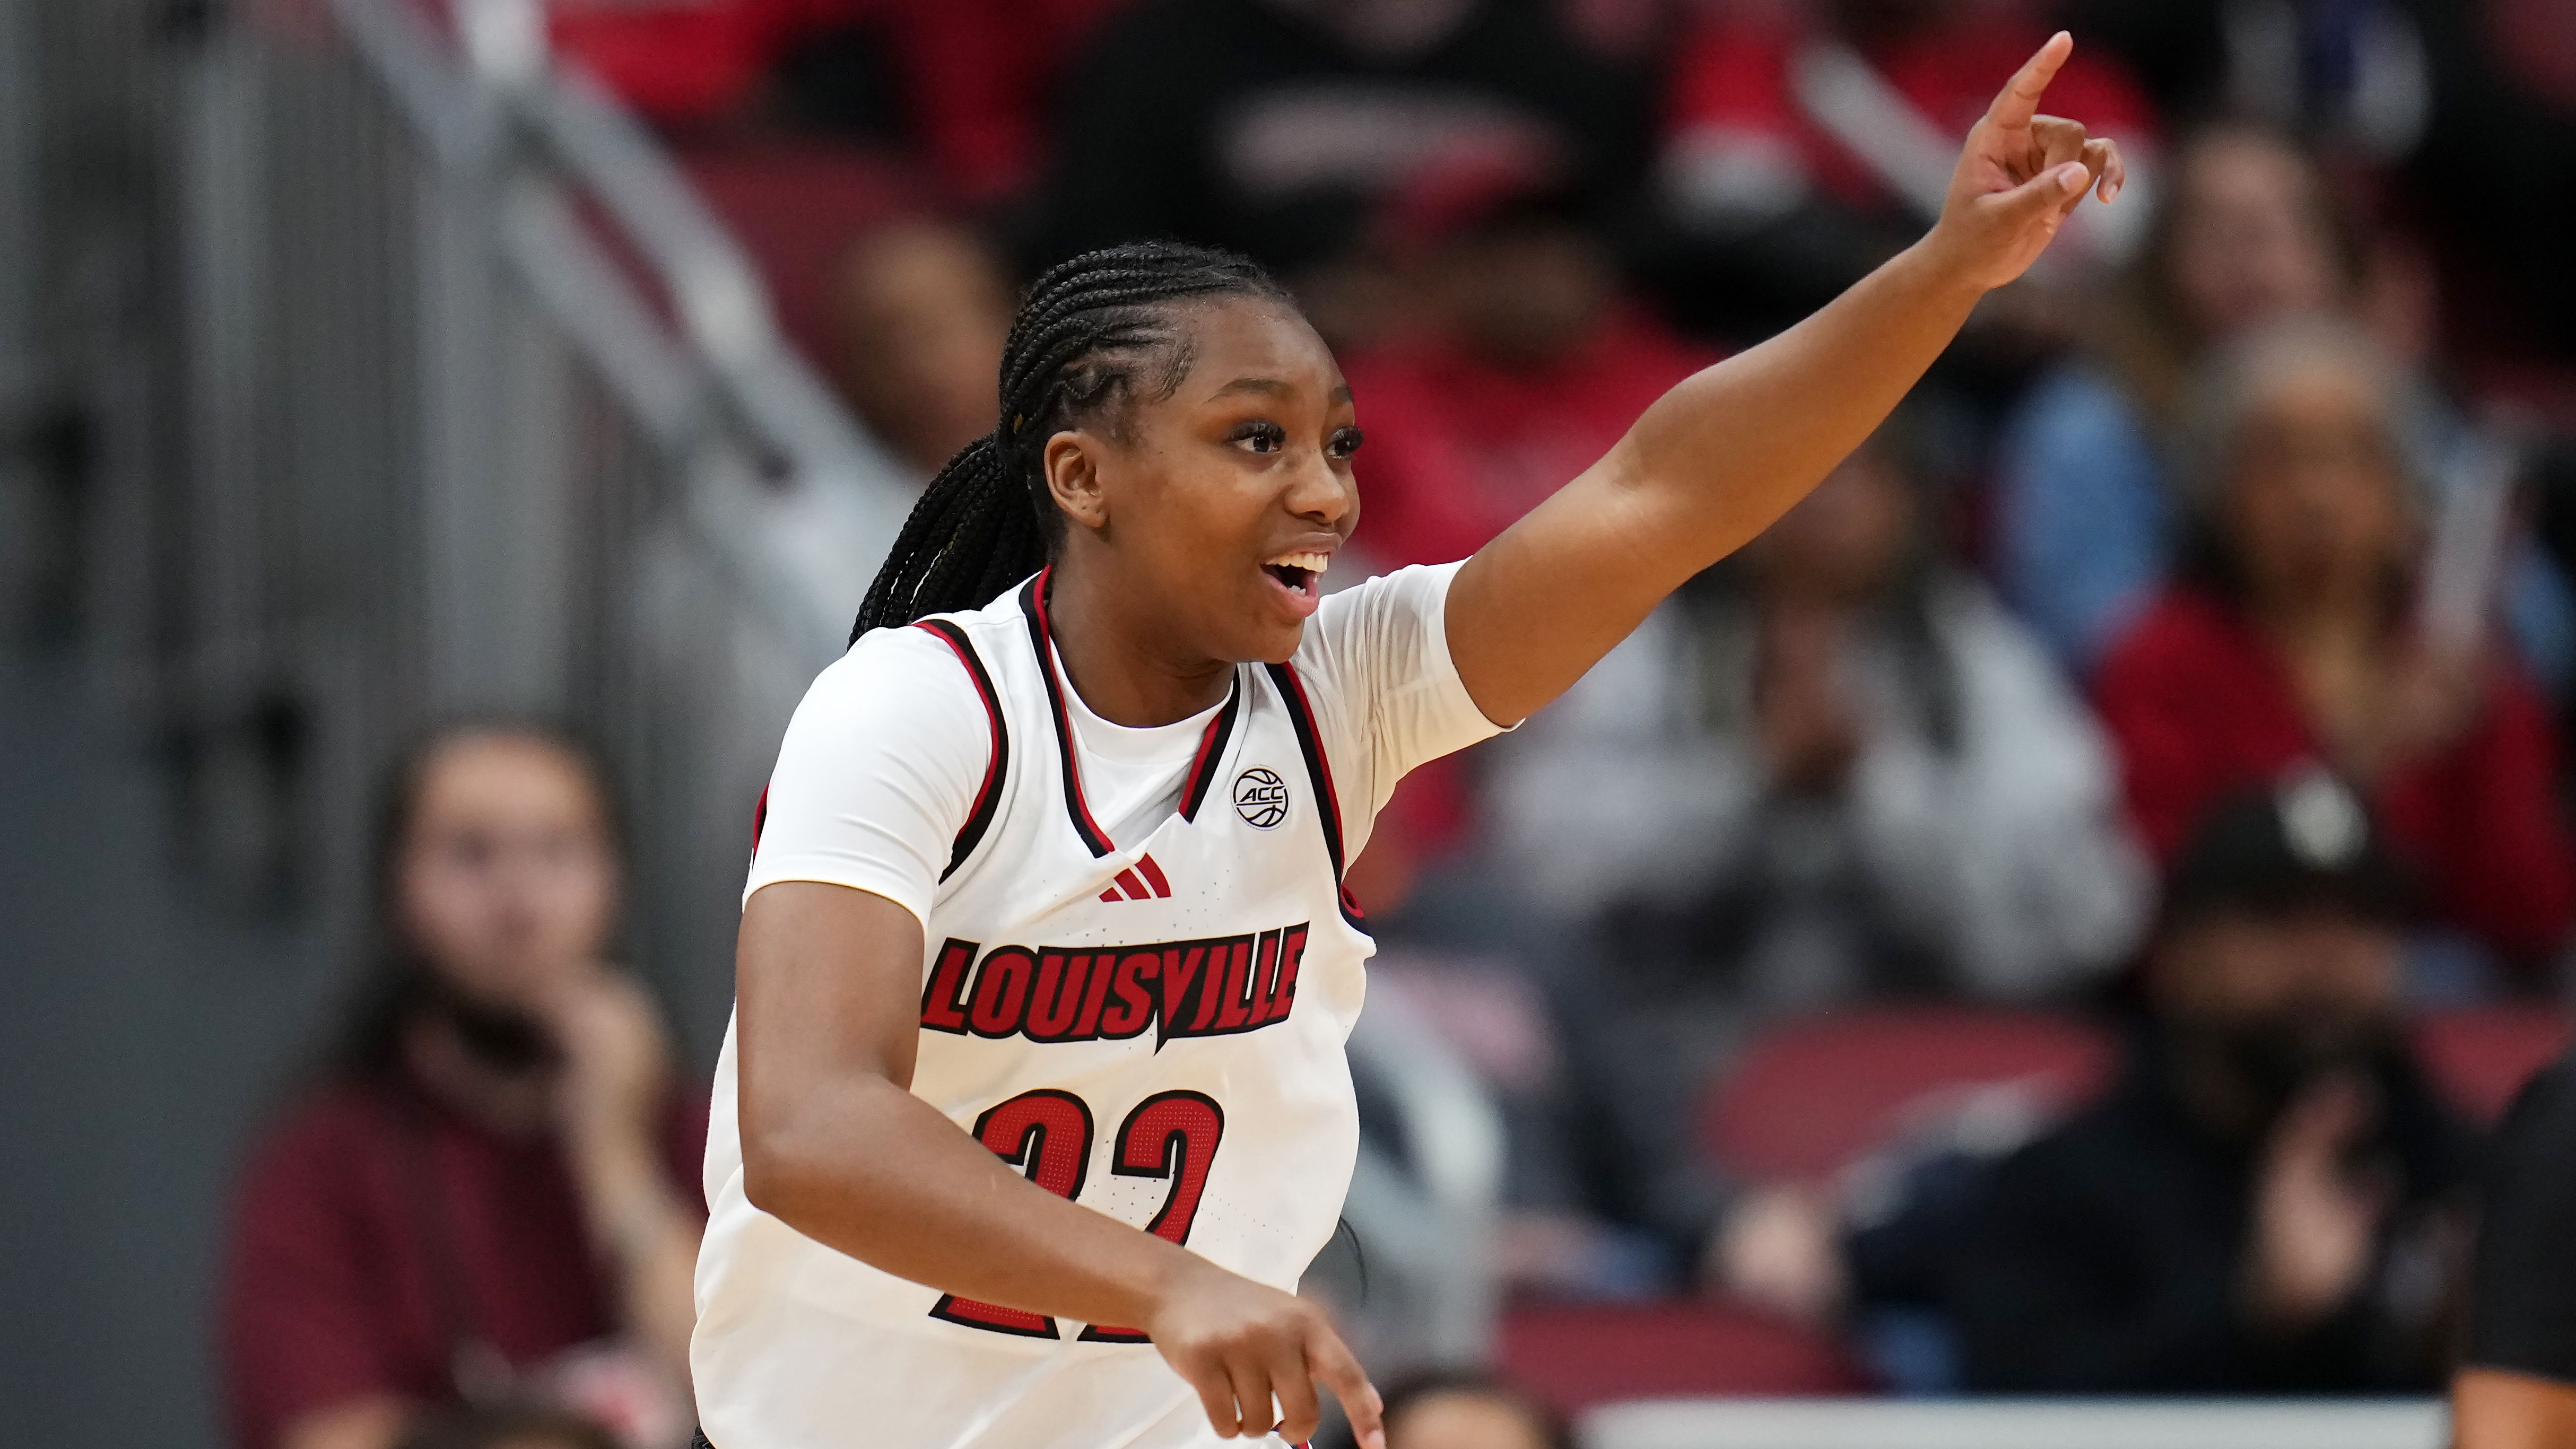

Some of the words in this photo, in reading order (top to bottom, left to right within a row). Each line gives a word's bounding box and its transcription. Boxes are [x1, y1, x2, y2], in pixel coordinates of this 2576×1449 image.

[1240, 785, 1285, 801] ACC
[920, 920, 1310, 1056] LOUISVILLE
[928, 1089, 1224, 1343] 22
